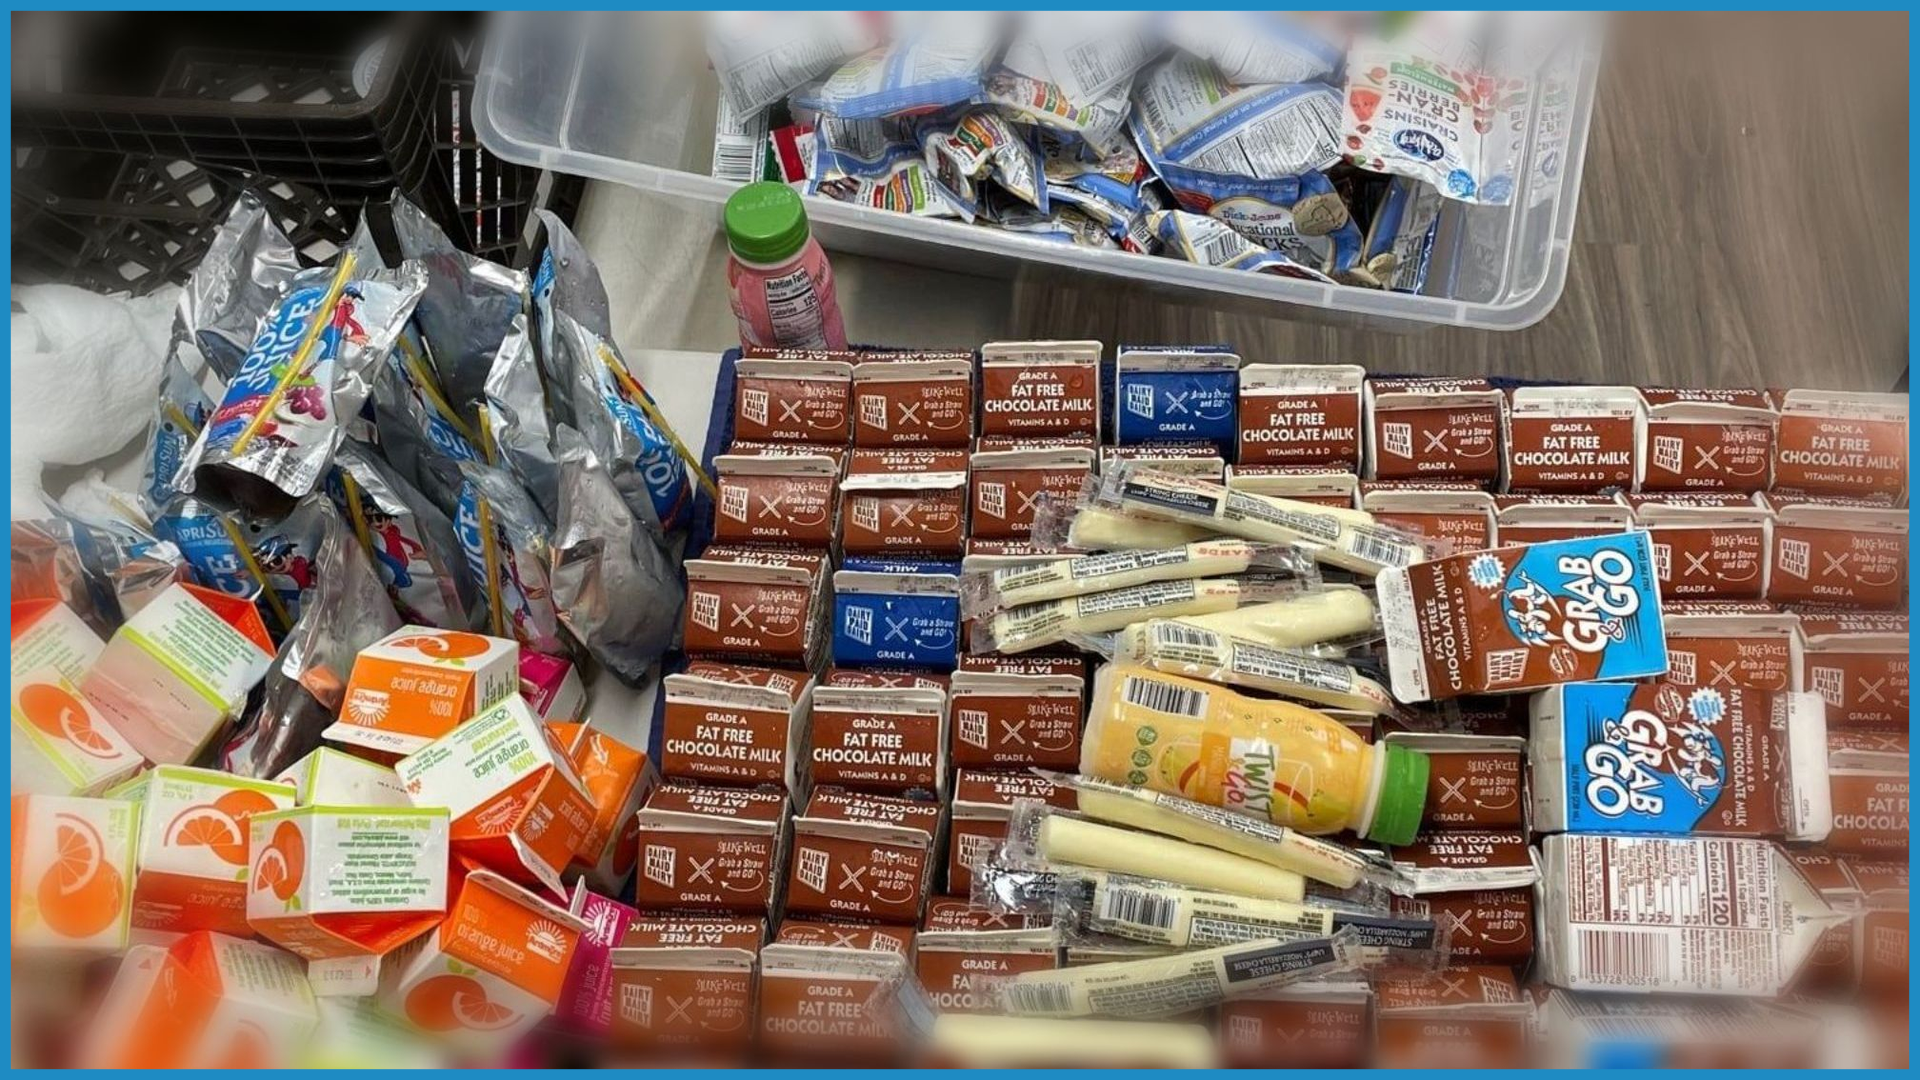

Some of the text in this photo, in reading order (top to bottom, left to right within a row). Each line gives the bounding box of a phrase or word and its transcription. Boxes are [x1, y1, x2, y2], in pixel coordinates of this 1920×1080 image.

[1388, 80, 1460, 112] BERRIES
[1384, 109, 1459, 142] CRAISINS
[1323, 143, 1336, 157] 120
[766, 269, 808, 291] Nutrition Facts
[803, 293, 817, 307] 125
[771, 306, 797, 316] Calories
[249, 300, 320, 390] JUICE
[1018, 371, 1049, 381] GRADE
[1011, 383, 1066, 397] FAT FREE
[985, 399, 1093, 413] CHOCOLATE MILK
[1278, 401, 1308, 409] GRADE
[1007, 419, 1043, 427] VITAMINS
[1270, 413, 1326, 426] FAT FREE
[1159, 423, 1187, 432] GRADE
[1550, 424, 1582, 433] GRADE
[773, 431, 800, 439] GRADE
[1243, 428, 1354, 442] CHOCOLATE MILK
[1544, 437, 1600, 450] FAT FREE
[1812, 437, 1870, 451] FAT FREE
[1266, 448, 1304, 456] VITAMINS
[1515, 452, 1630, 466] CHOCOLATE MILK
[1780, 450, 1900, 470] CHOCOLATE MILK
[1539, 472, 1578, 480] VITAMINS
[1685, 478, 1714, 487] GRADE
[1559, 548, 1640, 652] GRAB & GO
[1427, 599, 1445, 661] FAT FREE
[1434, 564, 1462, 691] CHOCOLATE MILK
[877, 651, 906, 660] GRADE
[966, 657, 1082, 666] CHOCOLATE MILK
[995, 665, 1052, 674] FAT FREE
[390, 677, 458, 698] orange juice
[428, 700, 454, 717] 100%
[706, 713, 737, 724] GRADE
[853, 719, 885, 729] GRADE
[696, 725, 753, 744] FAT FREE
[1602, 718, 1629, 743] &
[844, 733, 903, 749] FAT FREE
[498, 739, 530, 763] orange
[666, 740, 781, 764] CHOCOLATE MILK
[813, 748, 932, 768] CHOCOLATE MILK
[1730, 688, 1747, 827] FAT FREE CHOCOLATE MILK
[474, 755, 496, 779] juice
[509, 751, 538, 775] 100%
[690, 763, 729, 774] VITAMINS
[1620, 709, 1668, 817] GRAB
[839, 770, 879, 780] VITAMINS
[1584, 743, 1630, 818] GO
[1242, 745, 1275, 821] TWIST
[660, 786, 781, 802] CHOCOLATE MILK
[688, 795, 748, 808] FAT FREE
[1707, 841, 1729, 926] Calories 120
[1756, 841, 1769, 929] Nutrition Facts
[681, 892, 713, 902] GRADE
[1383, 937, 1413, 947] STRING
[497, 940, 525, 966] juice
[1249, 958, 1313, 977] STRING CHEESE
